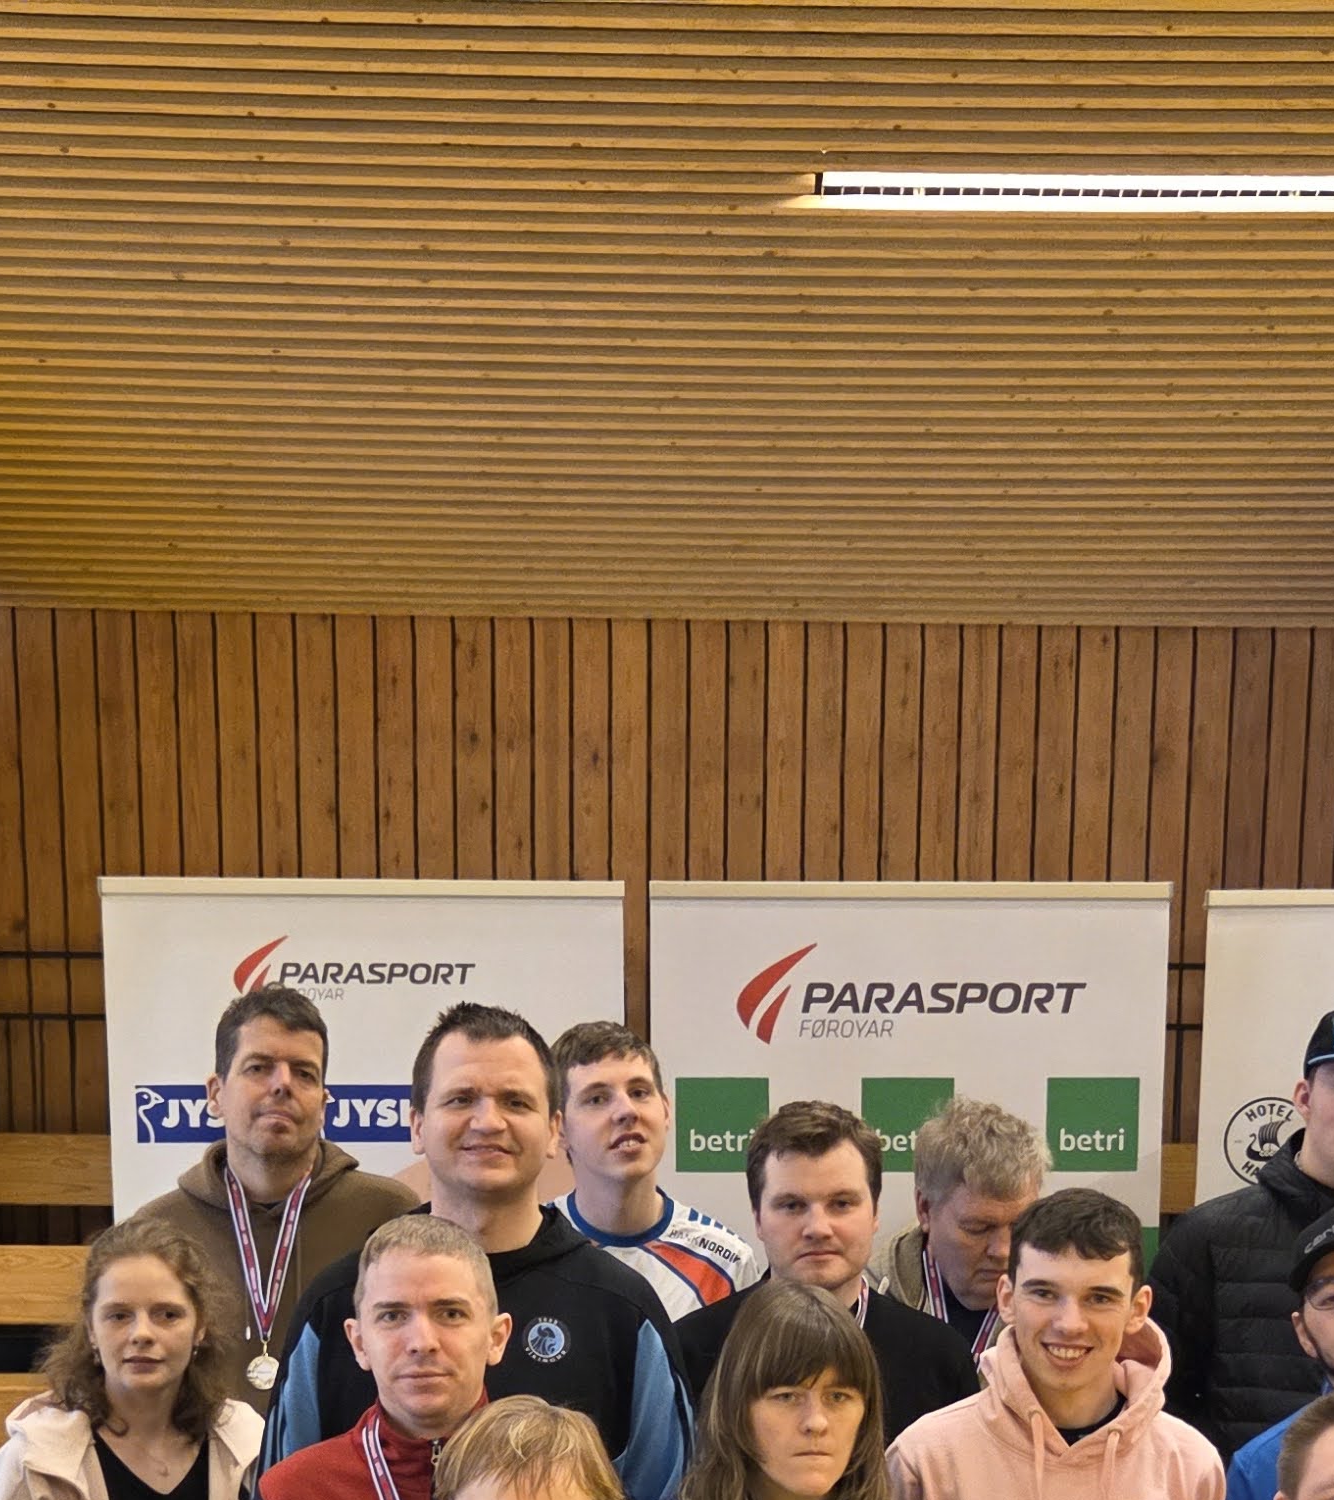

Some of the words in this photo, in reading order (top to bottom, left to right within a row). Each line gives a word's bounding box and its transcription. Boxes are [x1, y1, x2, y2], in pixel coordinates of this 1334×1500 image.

[278, 962, 476, 985] PARASPORT
[801, 982, 1088, 1014] PARASPORT
[799, 1018, 894, 1039] FØROYAR
[1245, 1103, 1294, 1122] HOTEL
[690, 1128, 755, 1152] betr
[876, 1128, 918, 1152] bet
[1059, 1127, 1125, 1152] betri
